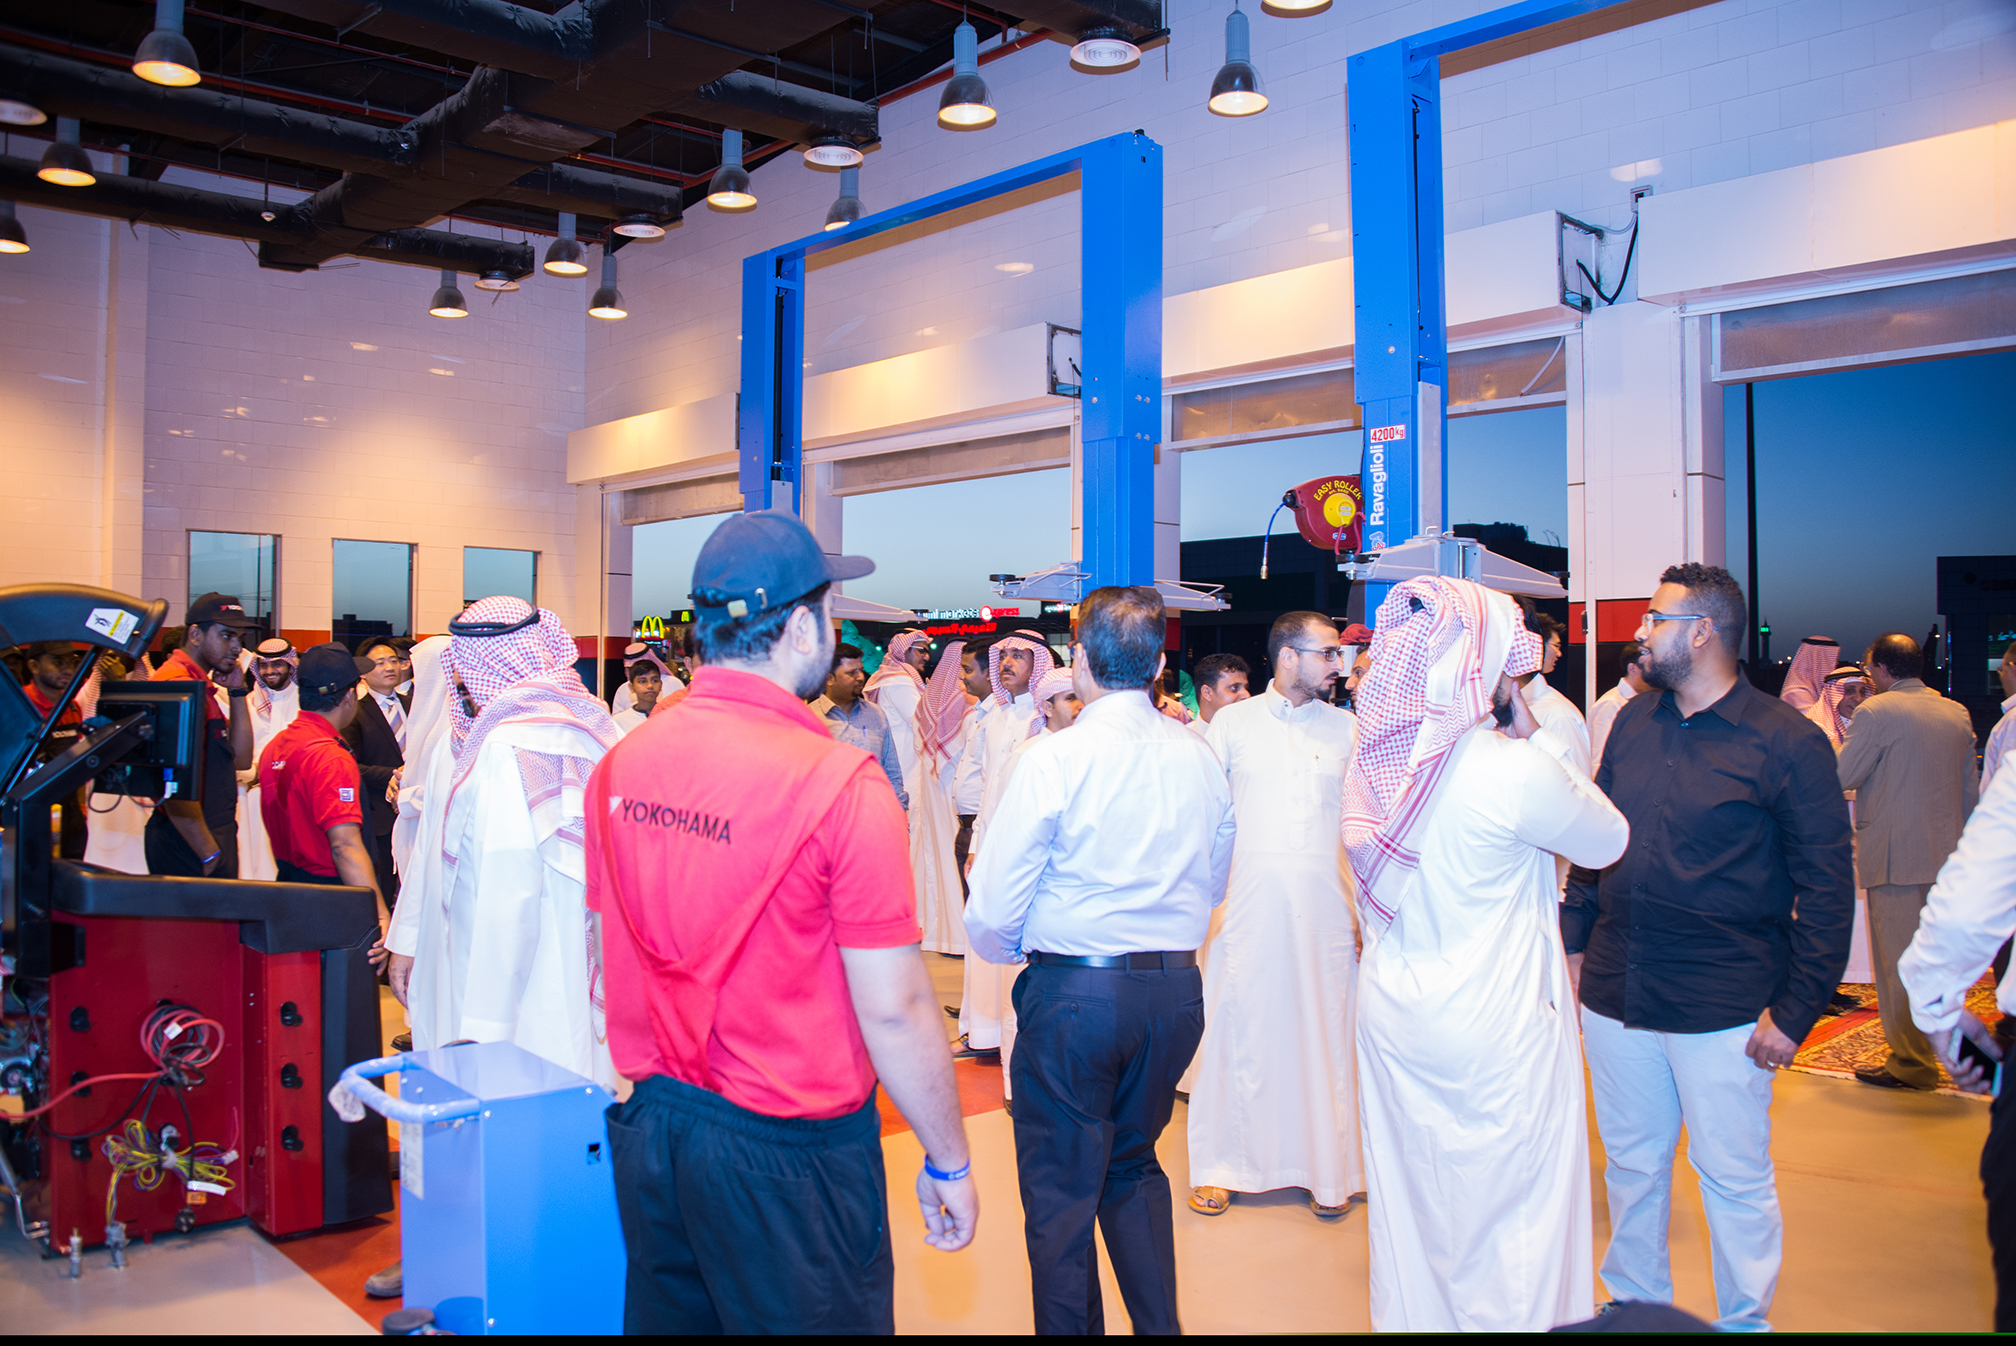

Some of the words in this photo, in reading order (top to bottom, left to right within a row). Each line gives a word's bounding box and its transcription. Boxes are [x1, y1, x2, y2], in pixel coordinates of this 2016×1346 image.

[1313, 481, 1332, 501] EASY
[1370, 444, 1387, 526] Ravaglioli
[621, 798, 731, 846] YOKOHAMA
